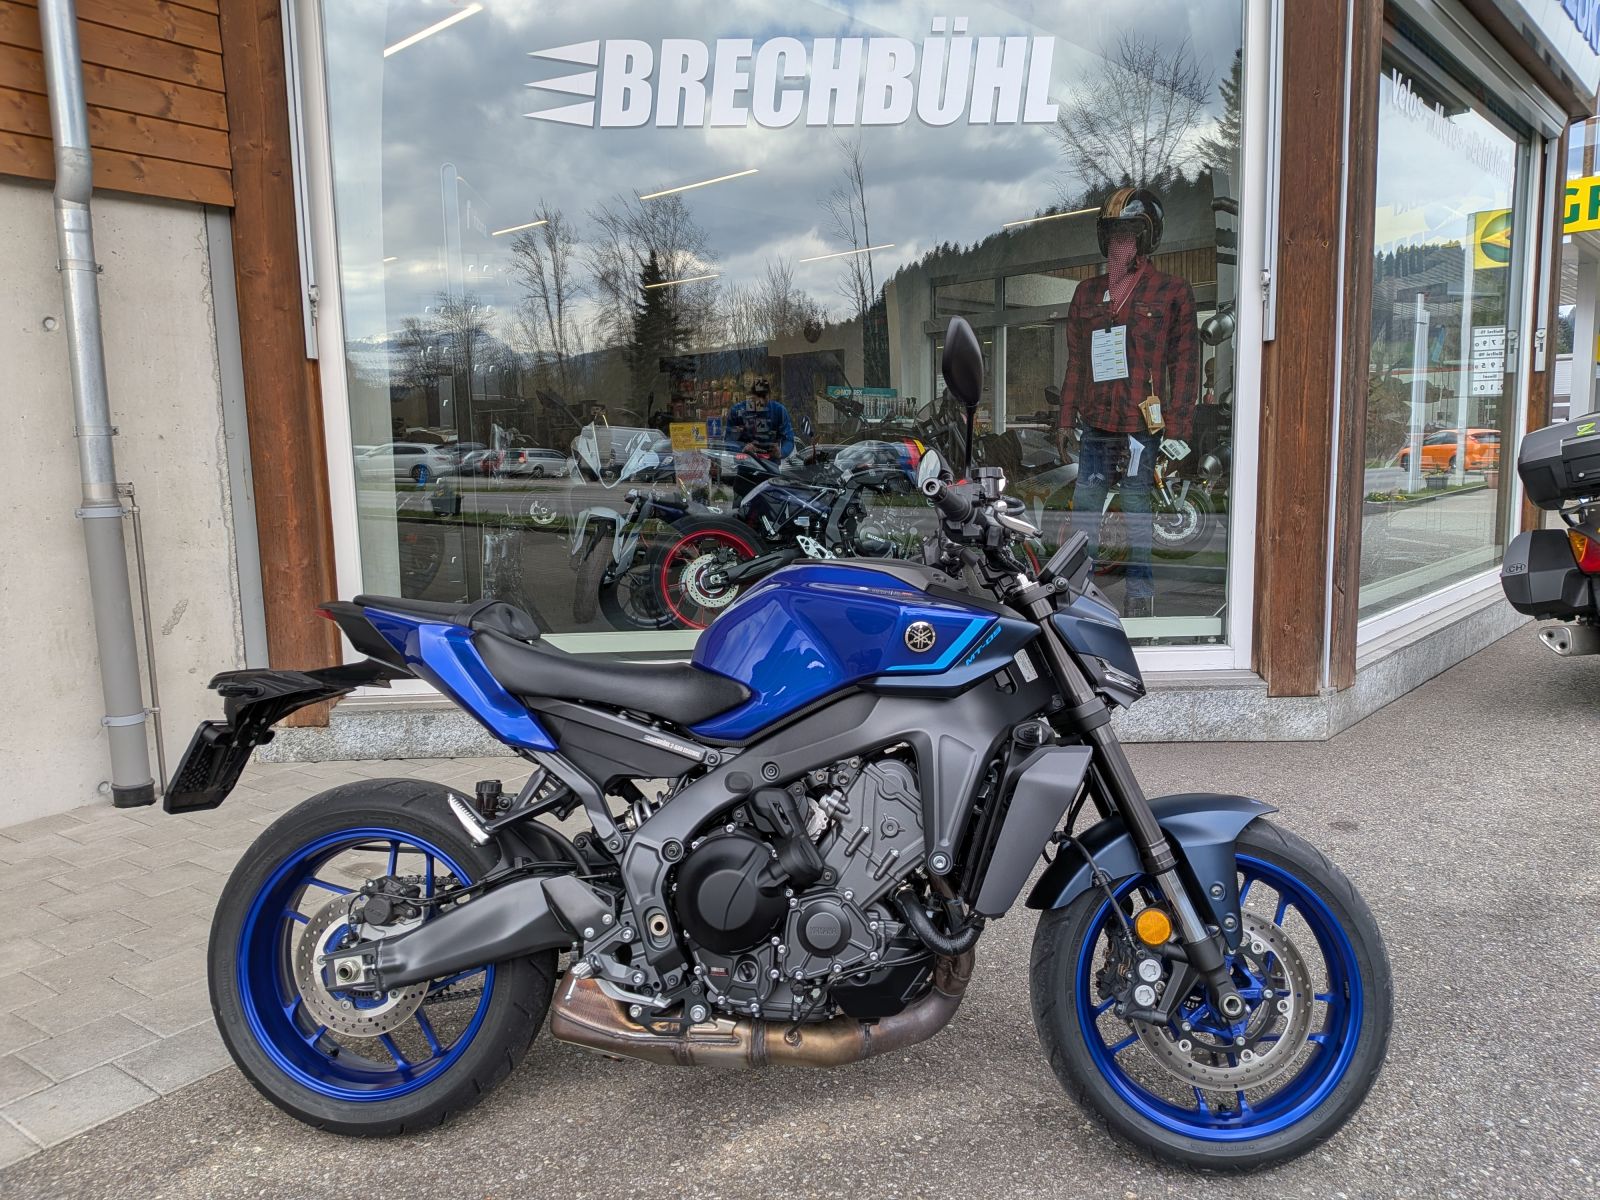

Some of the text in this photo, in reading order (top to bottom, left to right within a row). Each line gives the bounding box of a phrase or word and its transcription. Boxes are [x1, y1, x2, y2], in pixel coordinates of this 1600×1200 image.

[600, 16, 1059, 128] BRECHBÜHL
[1392, 68, 1425, 119] Velos
[1509, 564, 1523, 572] CH
[965, 625, 1002, 667] MT-09
